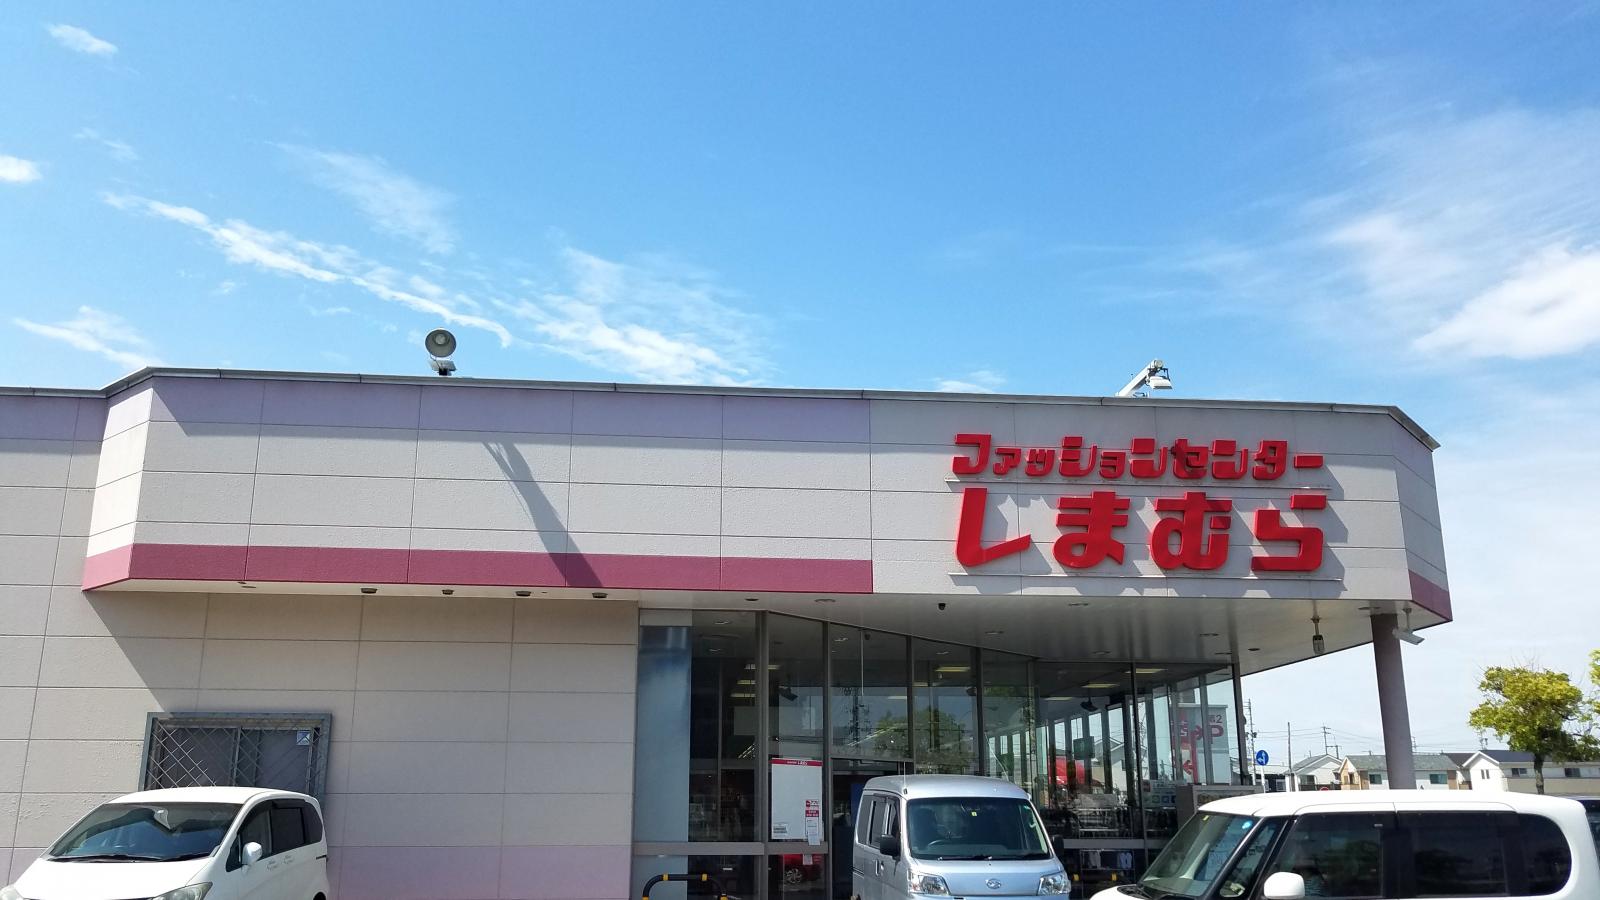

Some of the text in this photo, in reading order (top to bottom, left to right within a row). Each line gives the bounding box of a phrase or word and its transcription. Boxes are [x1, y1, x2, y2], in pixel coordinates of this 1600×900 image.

[952, 433, 1324, 480] ファッションセンター
[956, 488, 1327, 572] しまむら
